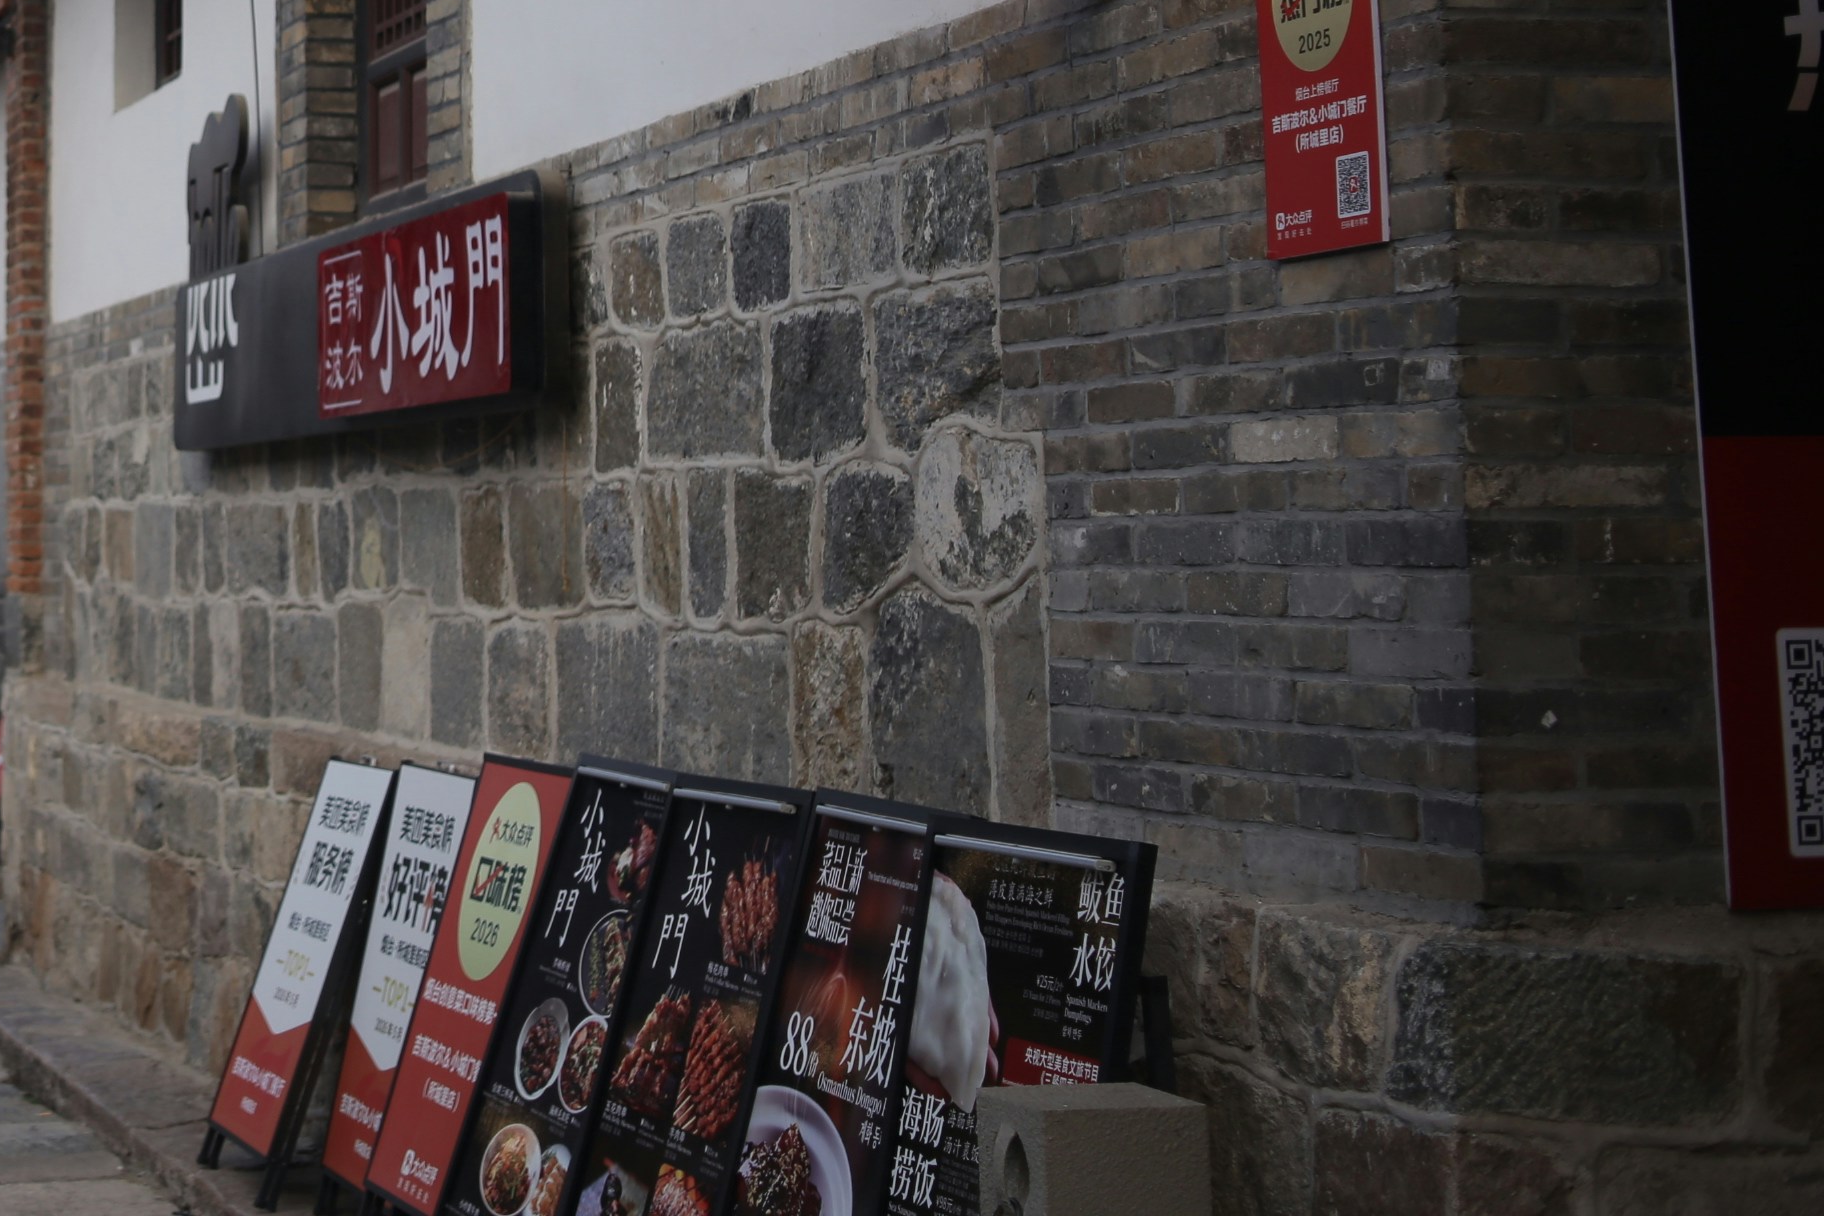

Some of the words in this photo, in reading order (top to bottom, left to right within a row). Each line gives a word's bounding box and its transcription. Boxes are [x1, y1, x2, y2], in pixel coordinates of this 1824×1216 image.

[1298, 28, 1331, 54] 2025
[1272, 95, 1368, 134] 吉斯波尔&小城门餐厅
[1285, 209, 1313, 227] 大众点评
[399, 804, 456, 855] 美团美食榜
[499, 819, 535, 848] 大众点评
[304, 840, 355, 896] 服务榜
[470, 856, 528, 912] 口味榜
[816, 840, 868, 895] 菜品上新
[805, 890, 856, 946] 邀你品尝
[1076, 870, 1125, 927] 鲅鱼
[470, 917, 500, 948] 2026
[1069, 932, 1117, 992] 水饺
[1064, 1006, 1092, 1025] Dumplings
[1066, 993, 1087, 1008] Spanish
[839, 995, 898, 1090] 东坡
[1024, 1045, 1100, 1083] 央视大型美食文旅节目
[816, 1070, 856, 1104] Osmanthus
[855, 1085, 883, 1119] Dongpo
[898, 1084, 946, 1148] 海肠
[889, 1144, 938, 1209] 捞饭
